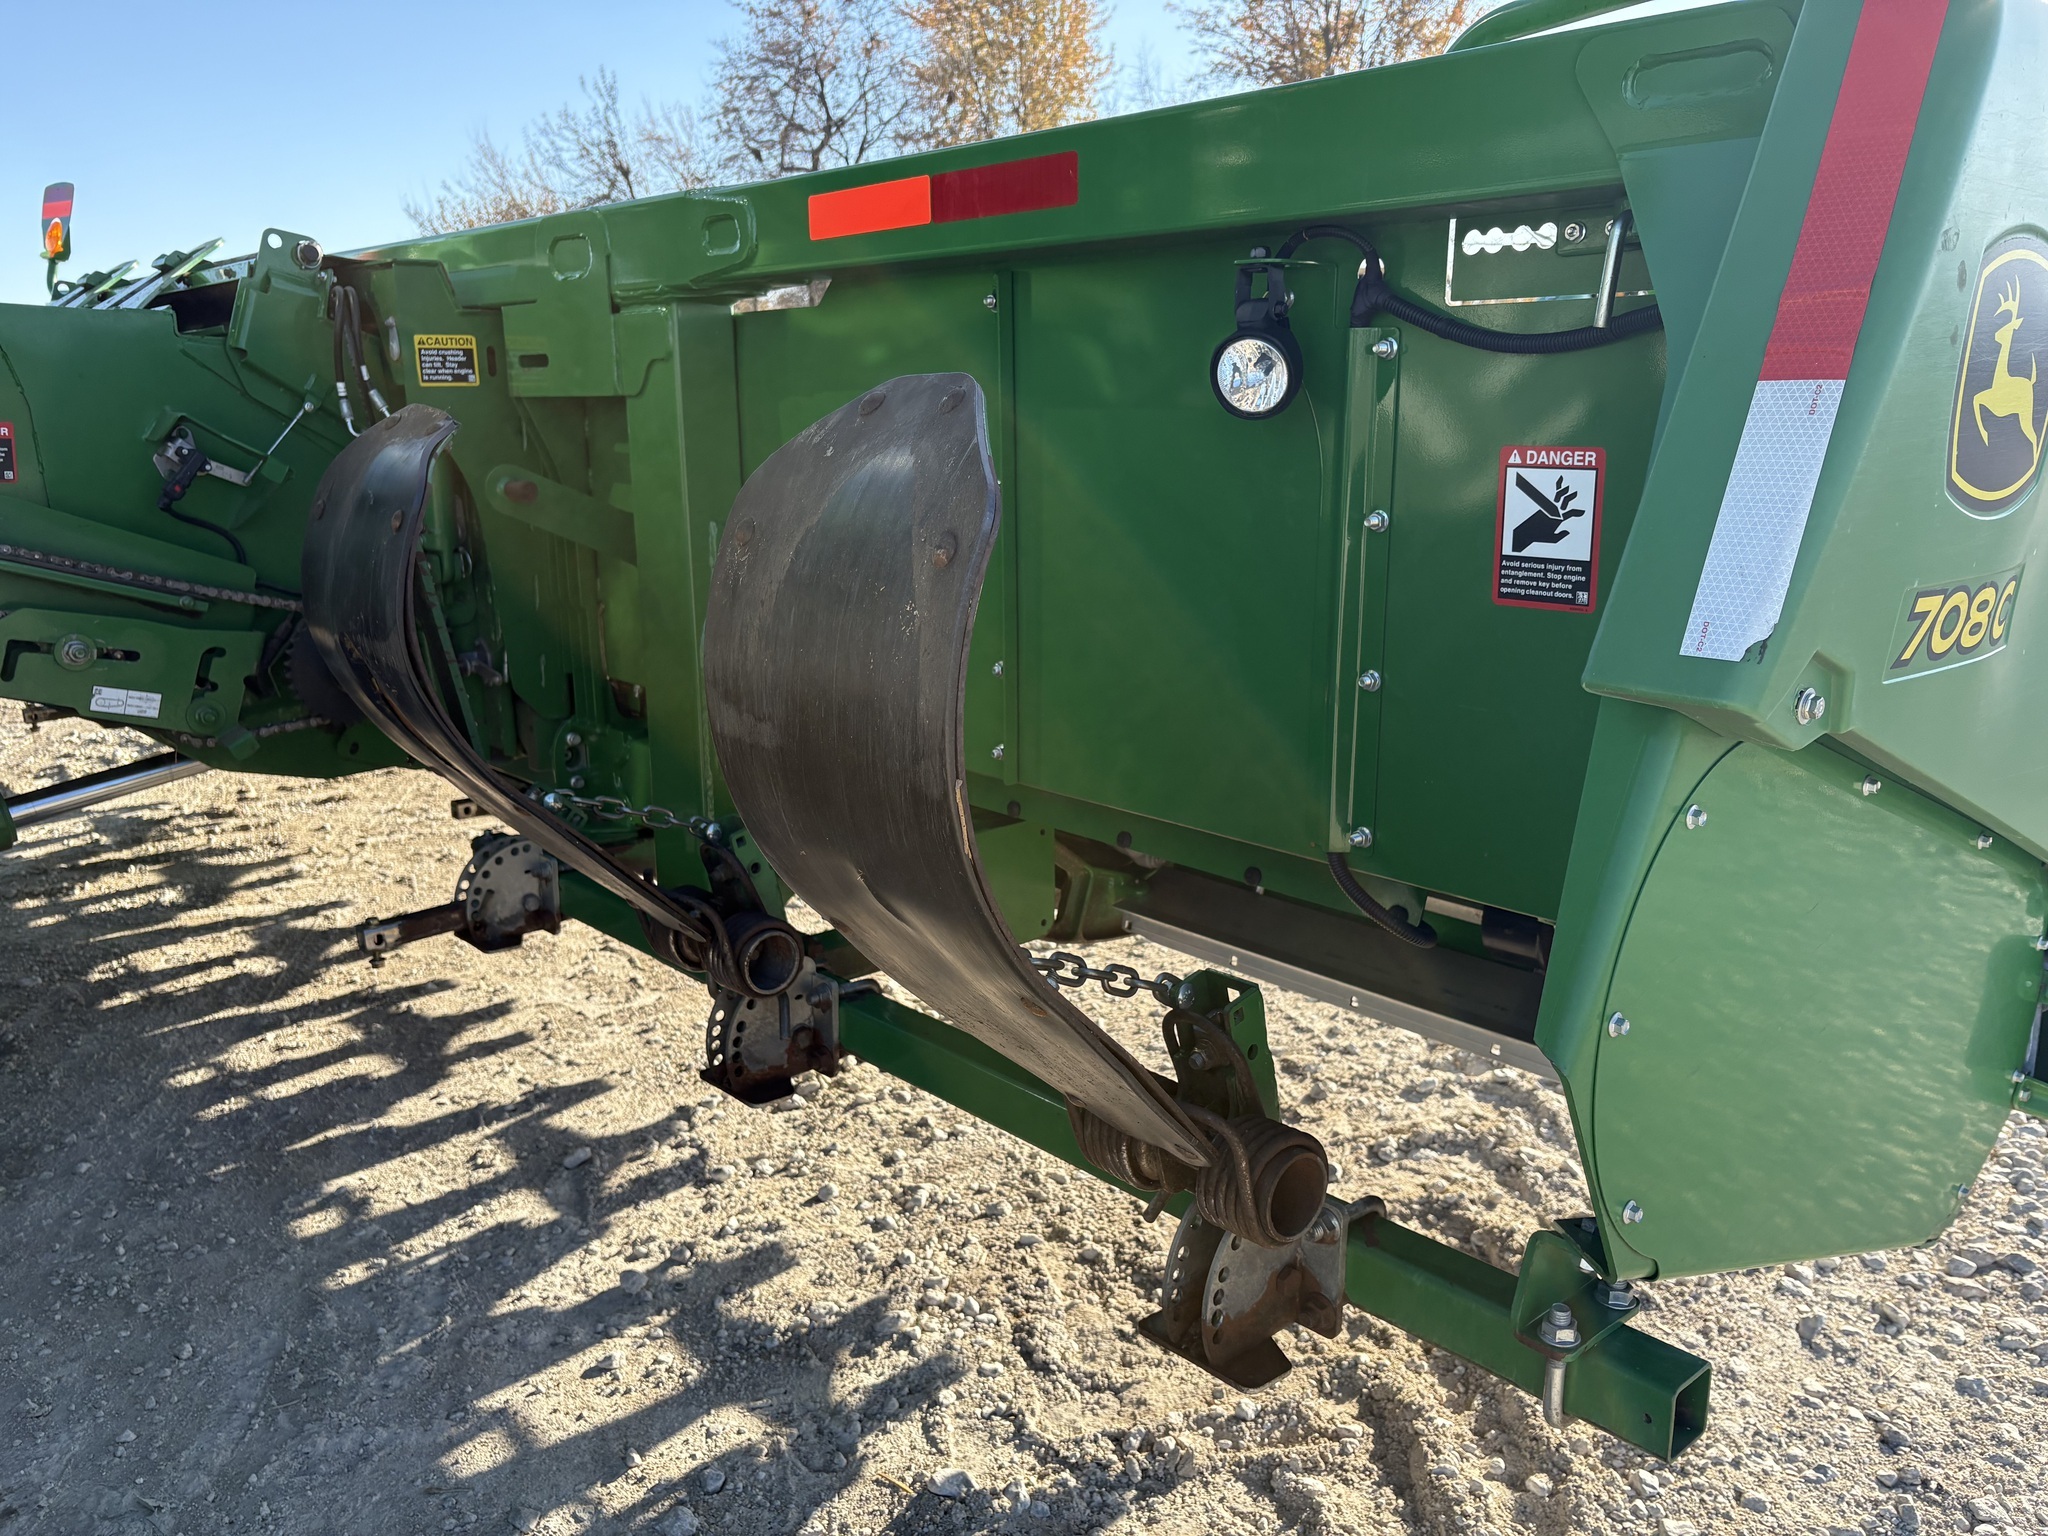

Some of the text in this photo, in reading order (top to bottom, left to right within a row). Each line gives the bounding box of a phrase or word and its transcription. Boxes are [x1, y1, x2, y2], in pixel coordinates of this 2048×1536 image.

[426, 337, 473, 346] CAUTION
[1809, 384, 1823, 416] DOT-C2
[1526, 450, 1597, 466] DANGER
[1521, 562, 1545, 570] serious
[1546, 564, 1565, 572] injury
[1501, 570, 1546, 578] entanglement.
[1547, 572, 1562, 580] Stop
[1538, 580, 1550, 588] key
[1500, 587, 1574, 598] opening cleanout doors.
[1890, 575, 2018, 670] 708C
[1696, 622, 1710, 652] DOT-C2
